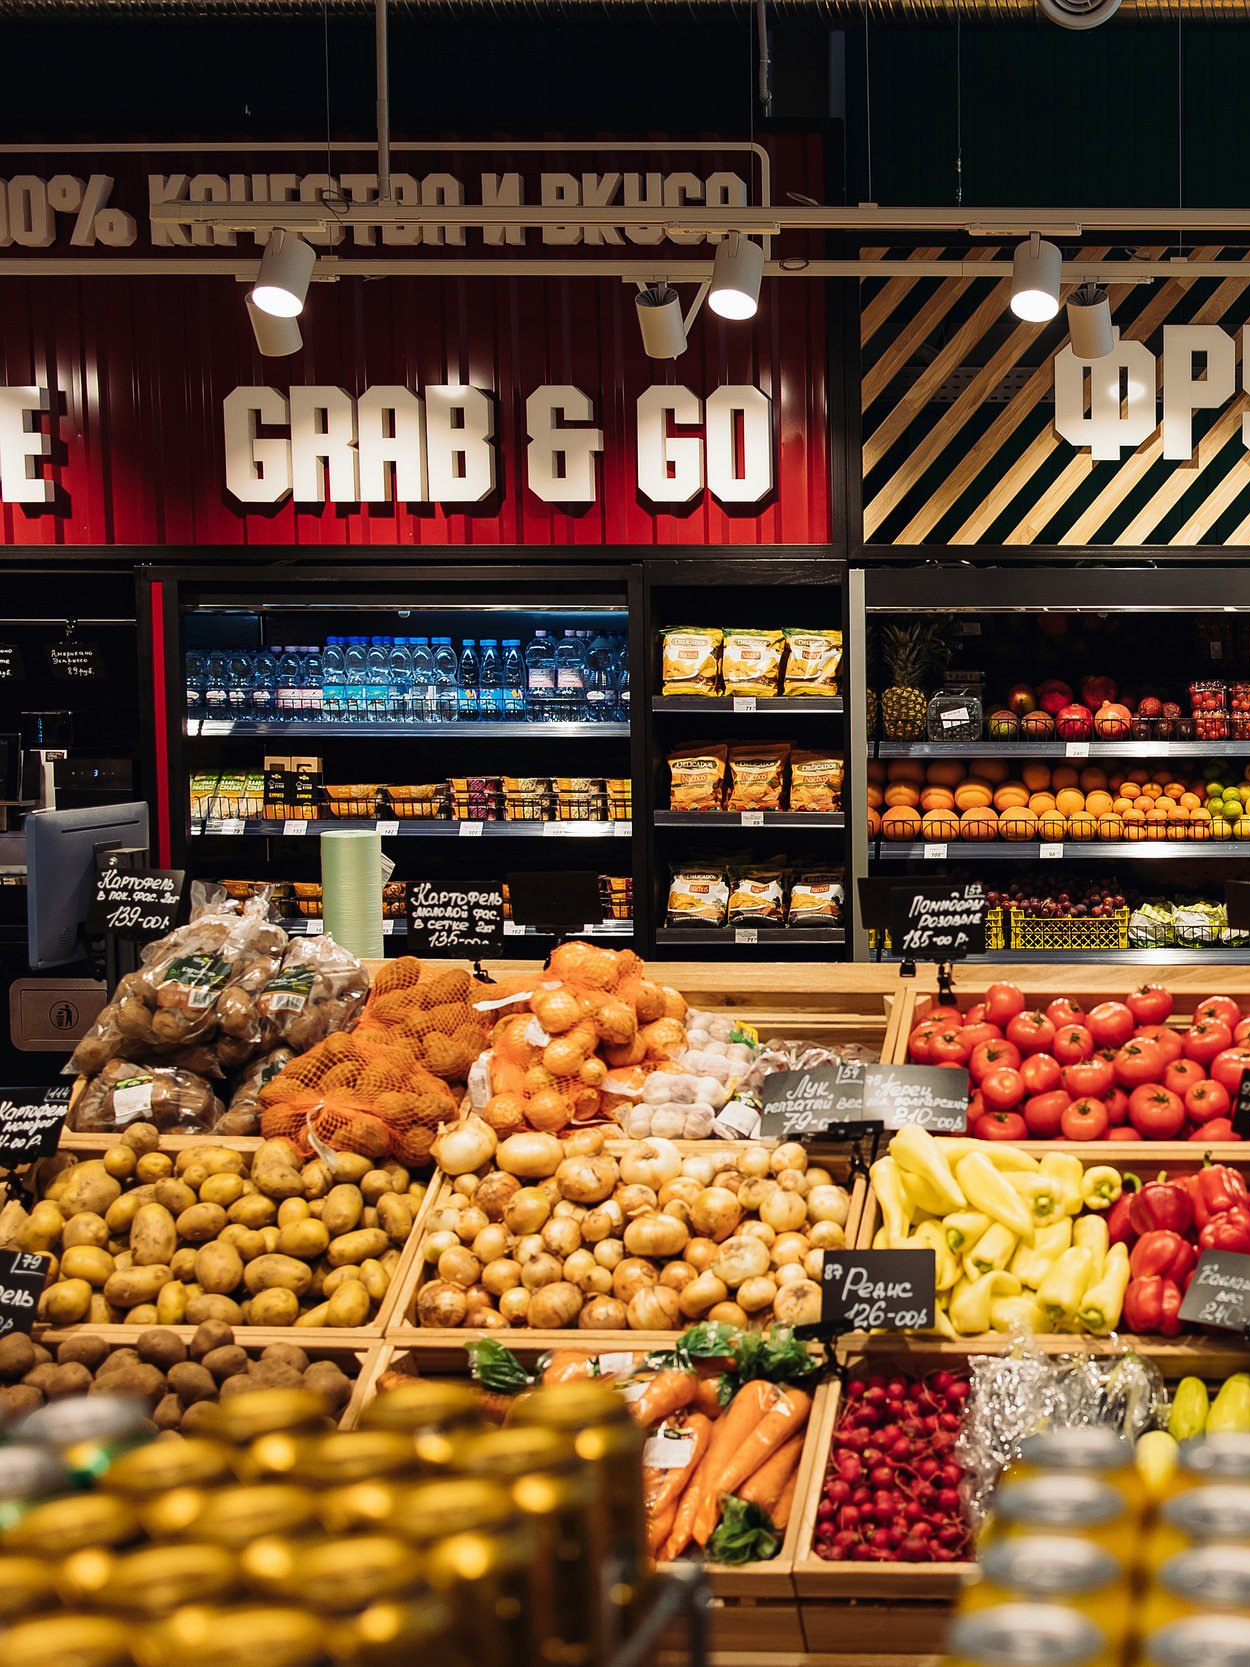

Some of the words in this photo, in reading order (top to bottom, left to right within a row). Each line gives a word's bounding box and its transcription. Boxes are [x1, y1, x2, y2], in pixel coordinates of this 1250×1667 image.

[0, 174, 137, 247] 0%
[481, 172, 525, 246] И
[541, 171, 748, 246] ВКУСА
[224, 385, 498, 503] GRAB
[526, 385, 604, 503] &
[637, 385, 775, 503] GO
[675, 760, 713, 769] DELICADOS
[802, 763, 837, 771] DELICADOS
[681, 774, 707, 783] Nachos
[97, 869, 175, 891] Картофель
[410, 883, 503, 906] Картофель
[427, 920, 470, 931] сетке
[824, 1263, 843, 1280] 87
[841, 1267, 914, 1301] Редис
